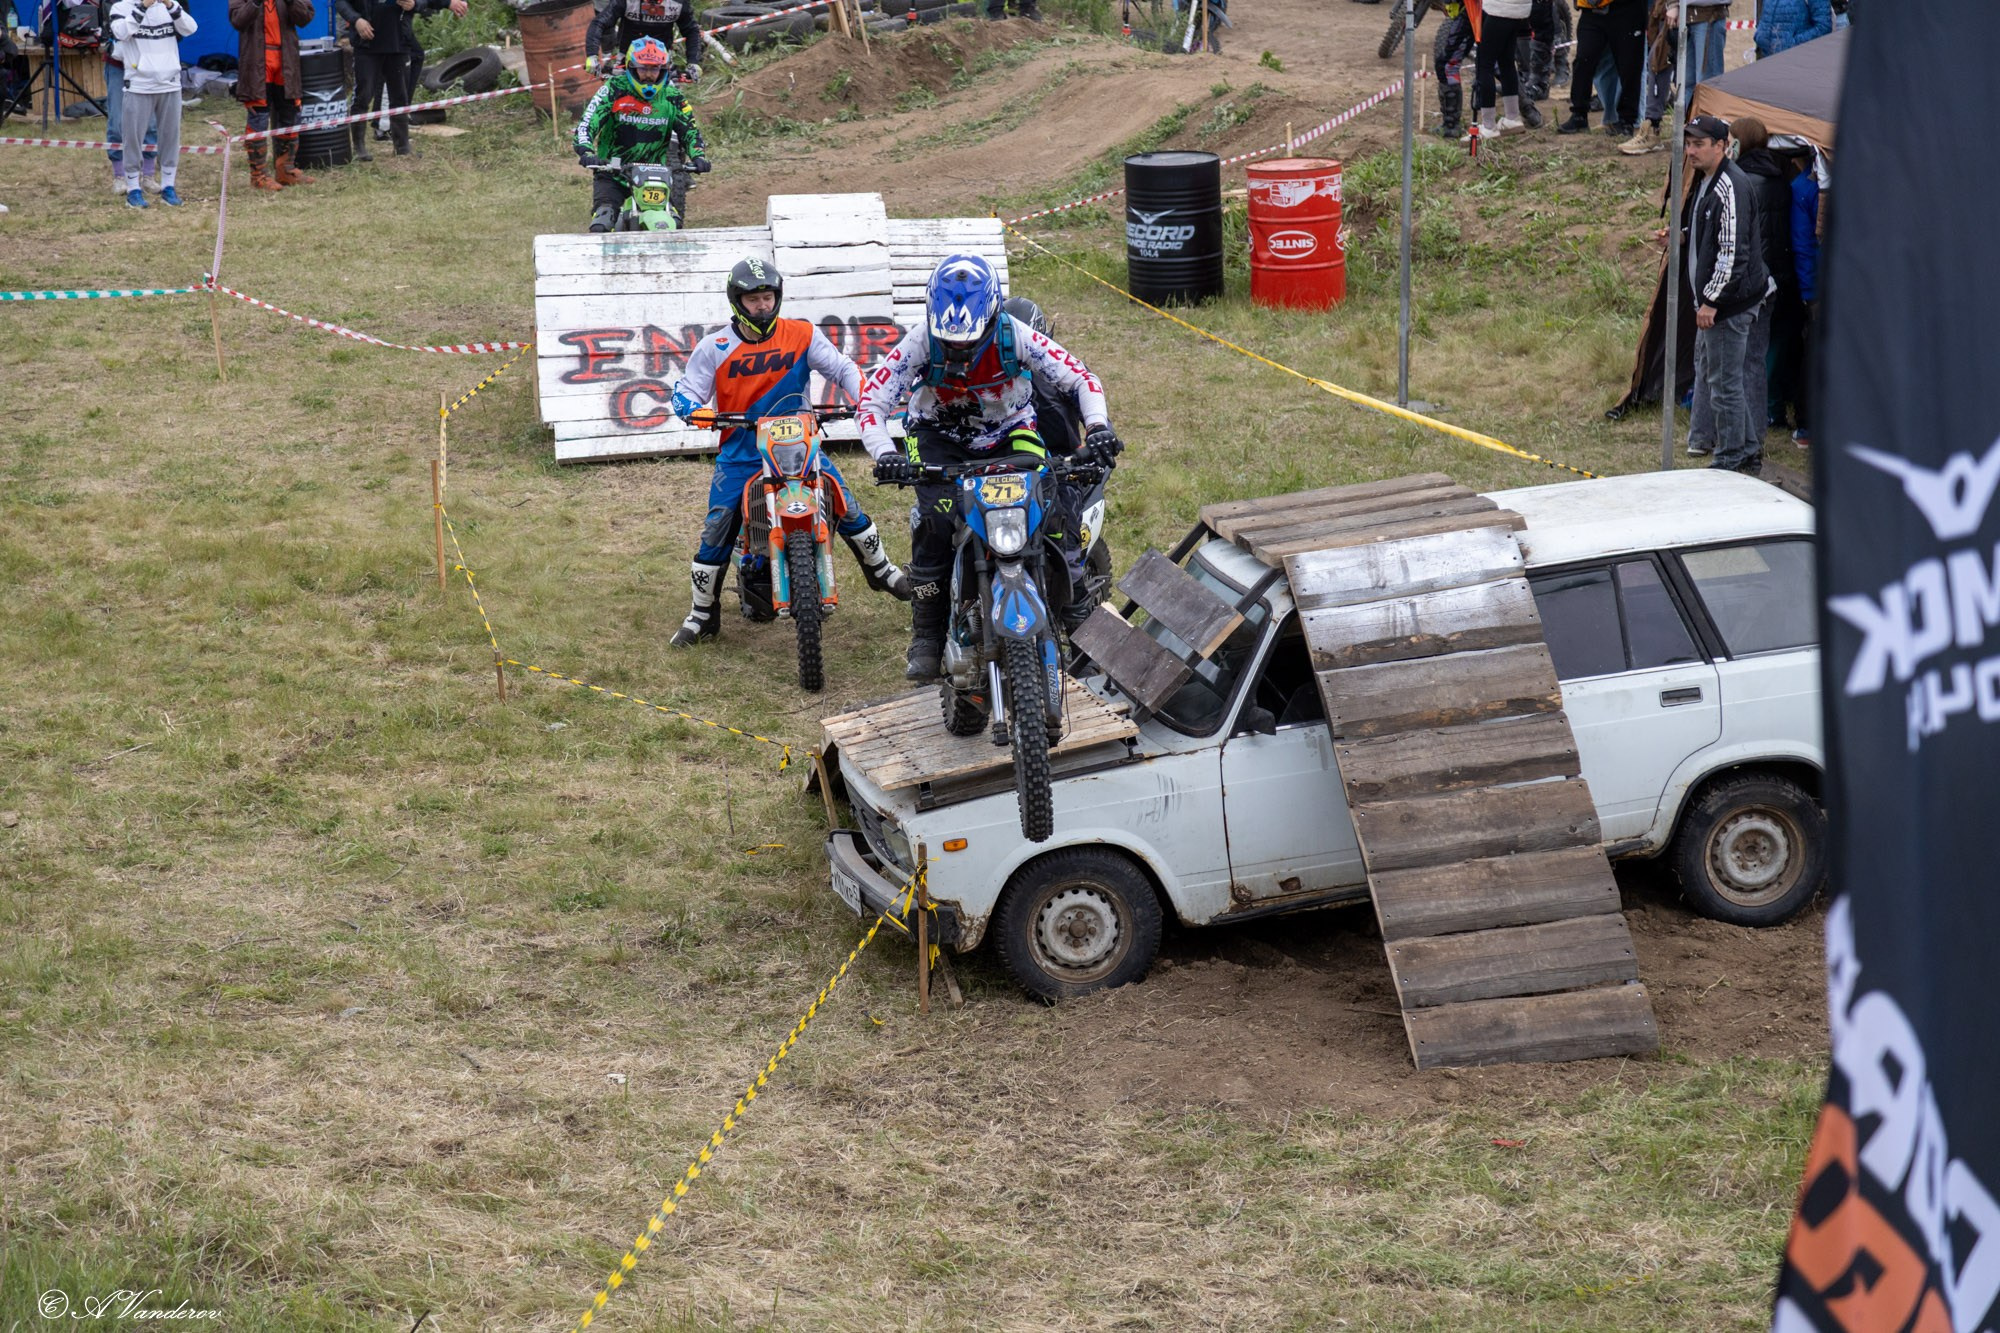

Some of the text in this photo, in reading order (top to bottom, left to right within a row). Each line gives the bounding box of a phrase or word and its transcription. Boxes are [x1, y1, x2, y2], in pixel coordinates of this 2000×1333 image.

[301, 100, 348, 117] ECOR
[618, 113, 669, 126] Kawasaki
[648, 191, 660, 201] 18
[1126, 223, 1195, 241] ECORD
[1148, 241, 1184, 250] RADIO
[1270, 238, 1315, 249] SINTEC
[1140, 249, 1160, 258] 104.4
[728, 349, 796, 379] KTM
[780, 426, 792, 435] 11
[993, 485, 1012, 498] 71
[1046, 663, 1060, 706] KENDA
